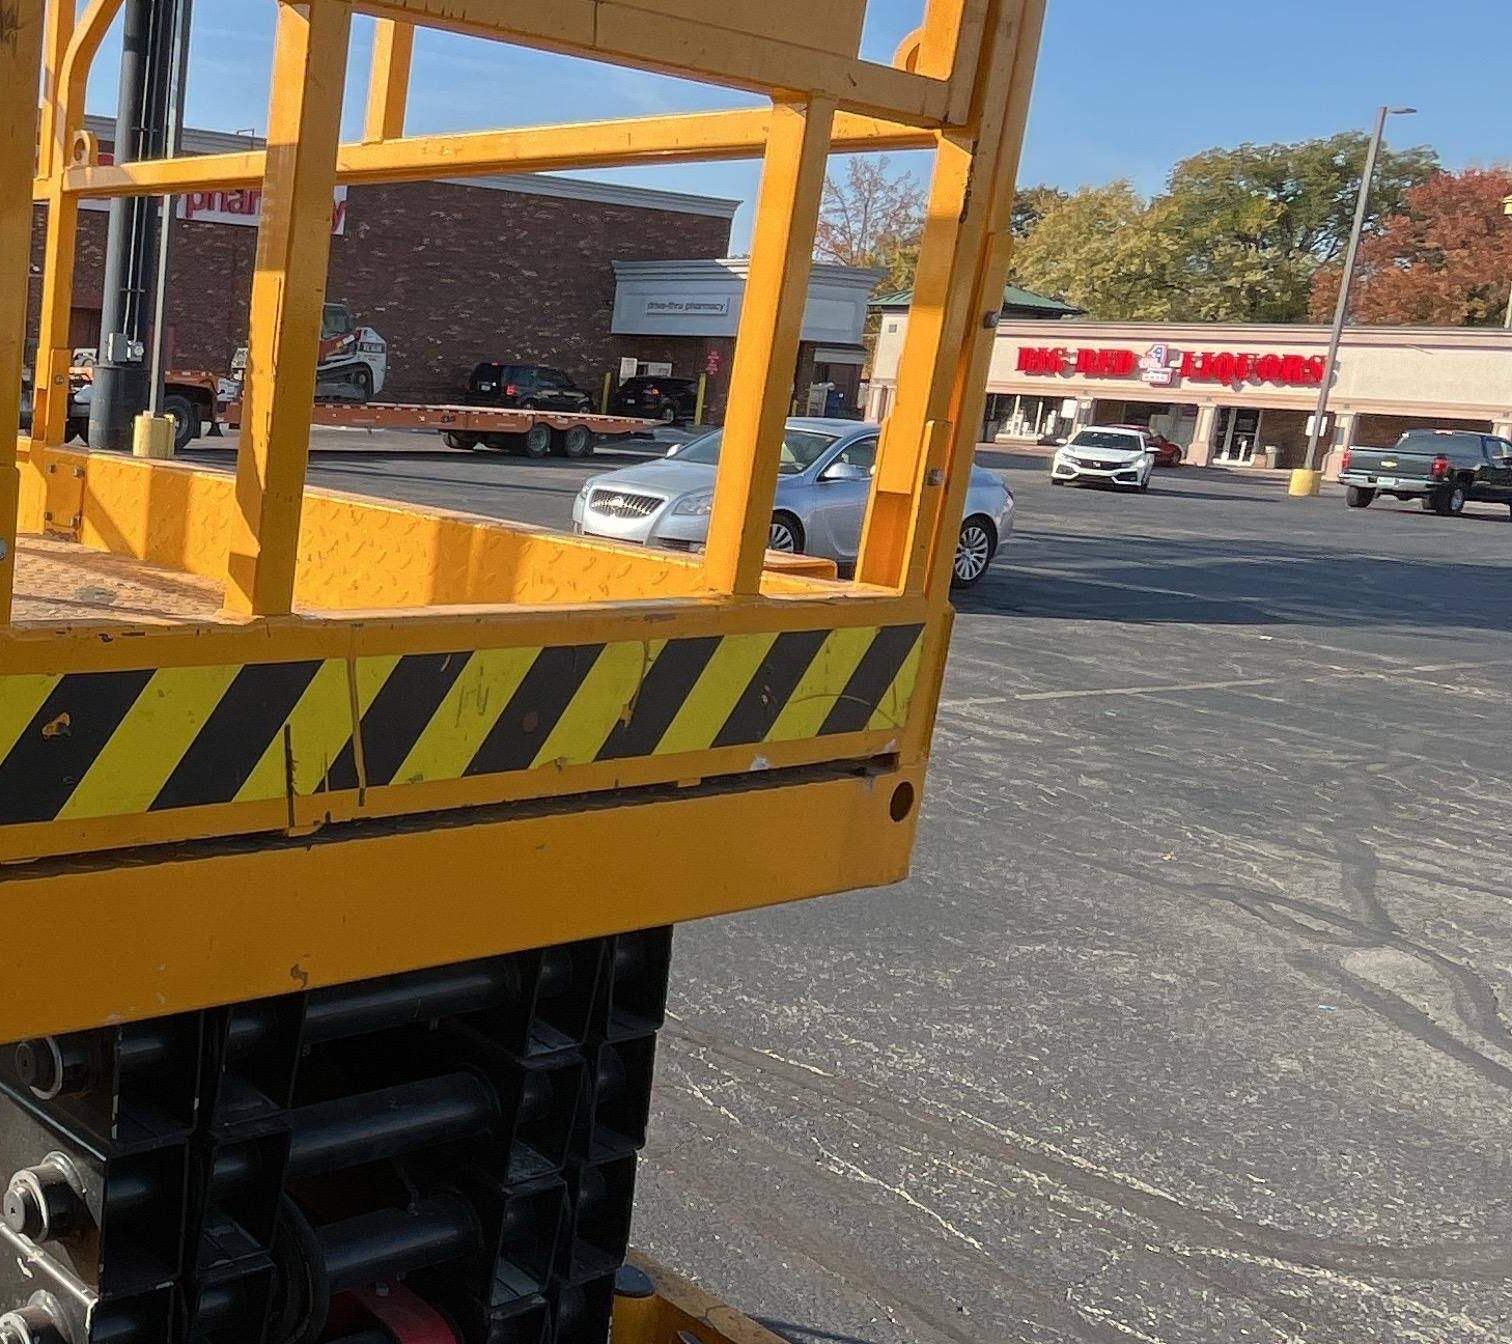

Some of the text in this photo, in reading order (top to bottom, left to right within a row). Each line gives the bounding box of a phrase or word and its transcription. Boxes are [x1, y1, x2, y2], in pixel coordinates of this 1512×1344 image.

[1015, 346, 1135, 375] BIG RED
[1181, 351, 1327, 387] LIQUORS
